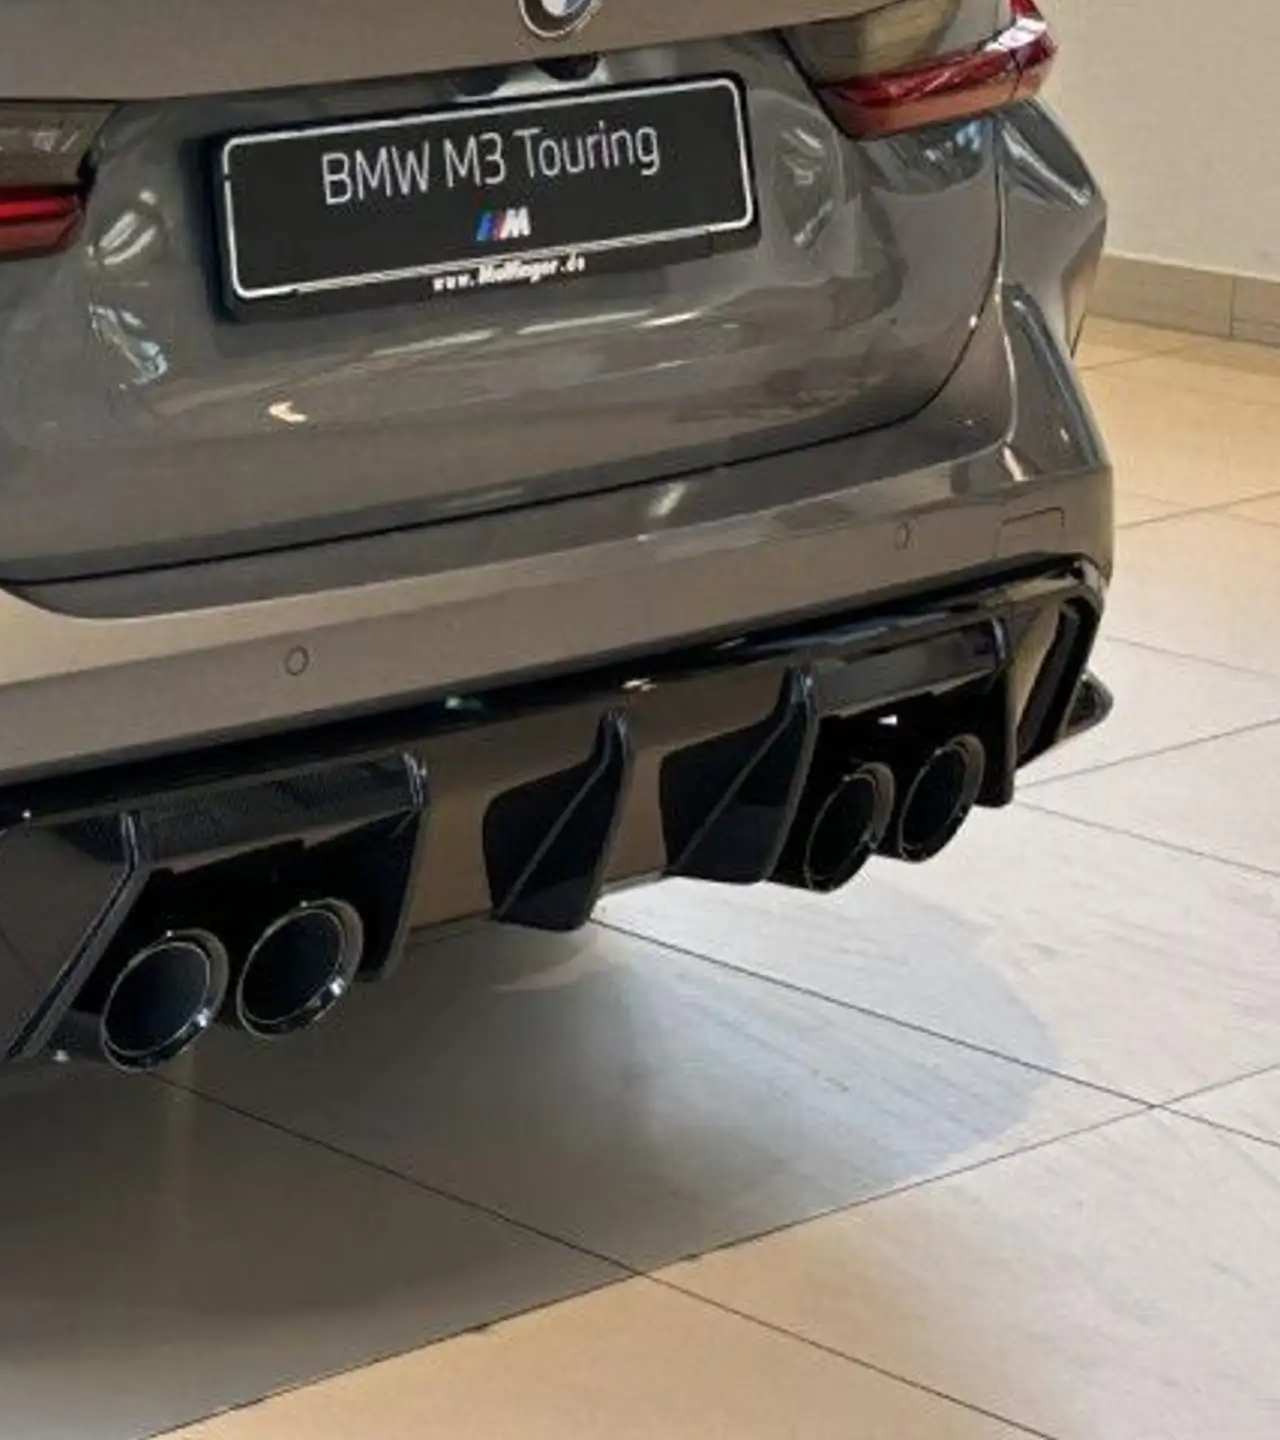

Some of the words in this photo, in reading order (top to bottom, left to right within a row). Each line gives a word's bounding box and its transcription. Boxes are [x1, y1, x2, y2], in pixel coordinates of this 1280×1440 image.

[321, 140, 430, 206] BMW
[443, 131, 507, 188] M3
[512, 120, 660, 176] Touring
